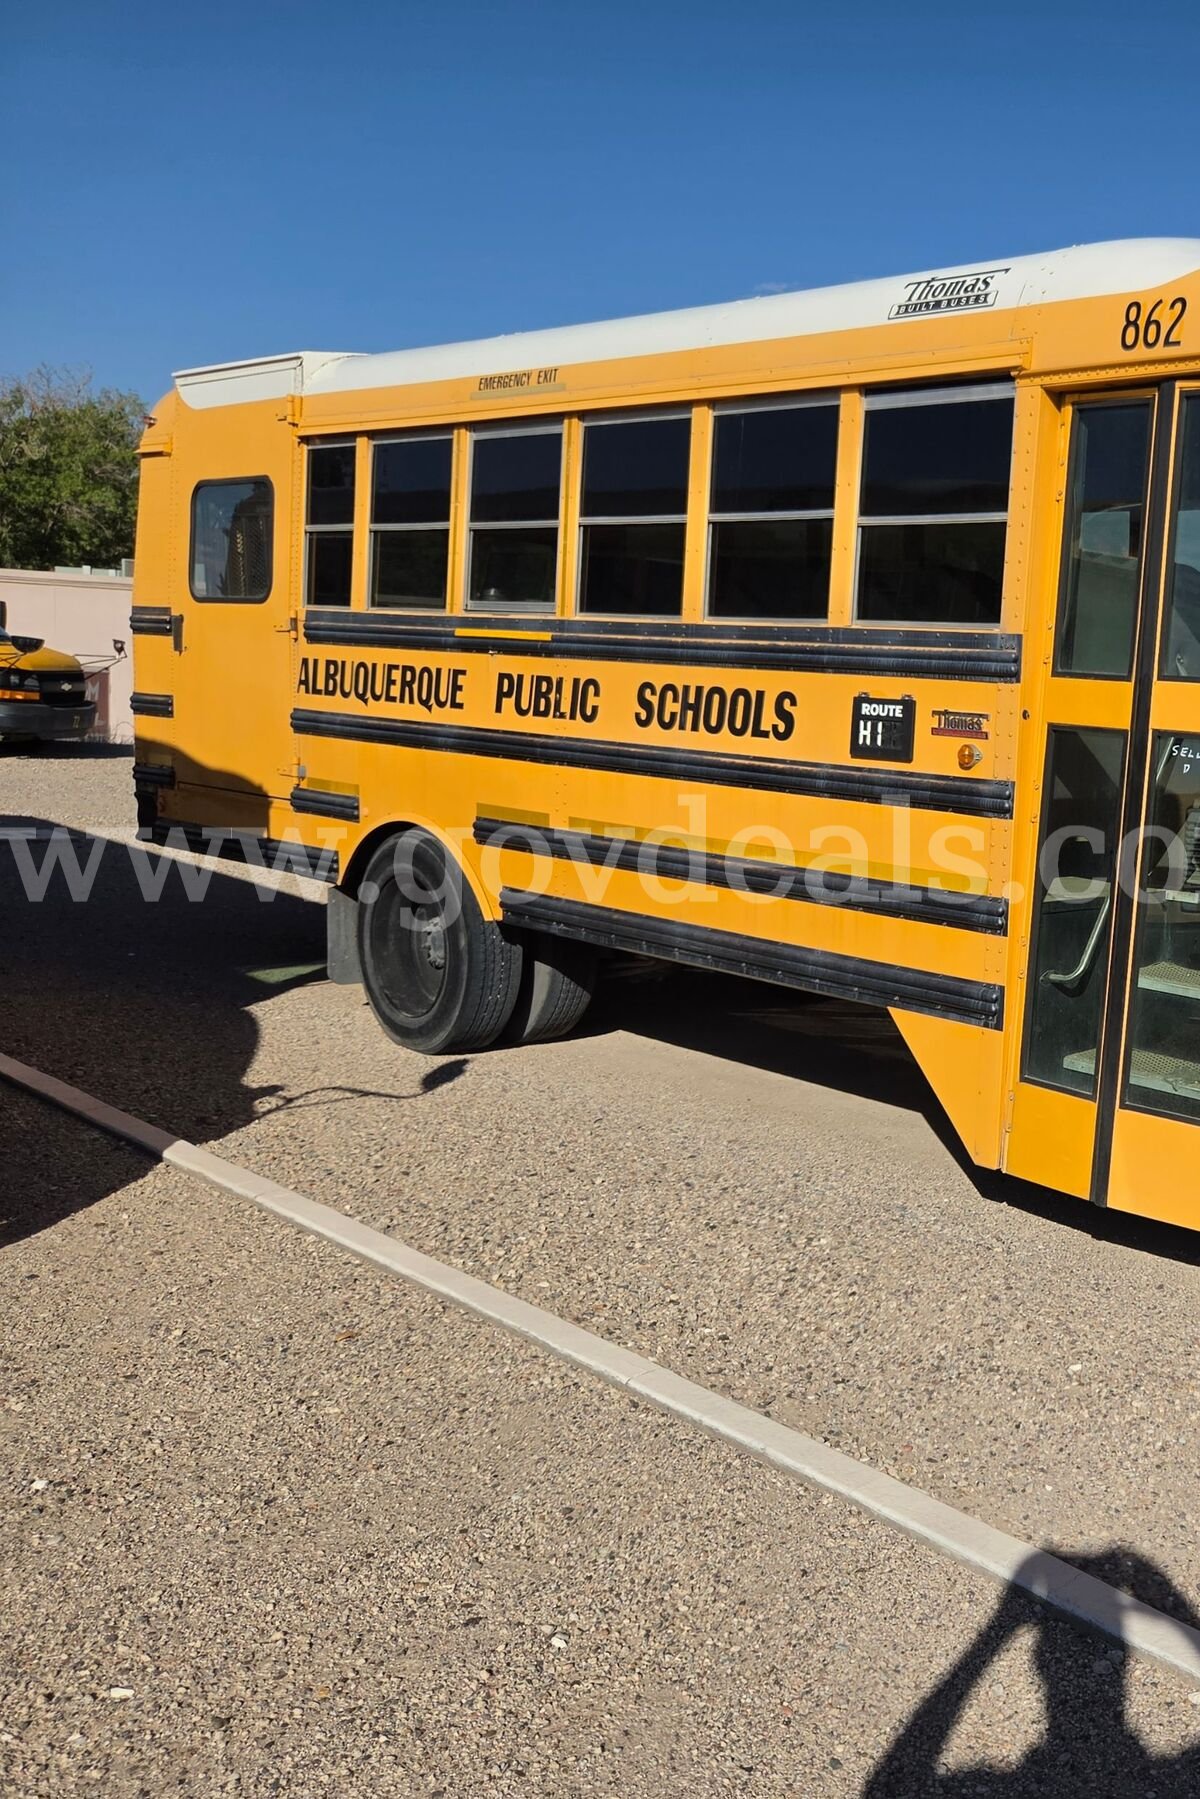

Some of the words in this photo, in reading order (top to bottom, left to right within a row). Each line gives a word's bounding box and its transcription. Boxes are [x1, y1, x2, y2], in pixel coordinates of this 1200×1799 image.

[904, 269, 1011, 302] Thomas
[899, 302, 936, 314] BUILT
[940, 294, 986, 309] BUSES
[1120, 296, 1187, 351] 862
[478, 372, 533, 392] EMERGENCY
[537, 368, 560, 386] EXIT
[296, 656, 467, 714] ALBUQUERQUE
[495, 671, 601, 724] PUBLIC
[634, 681, 798, 742] SCHOOLS
[861, 702, 904, 718] ROUTE
[931, 709, 990, 731] Thomas
